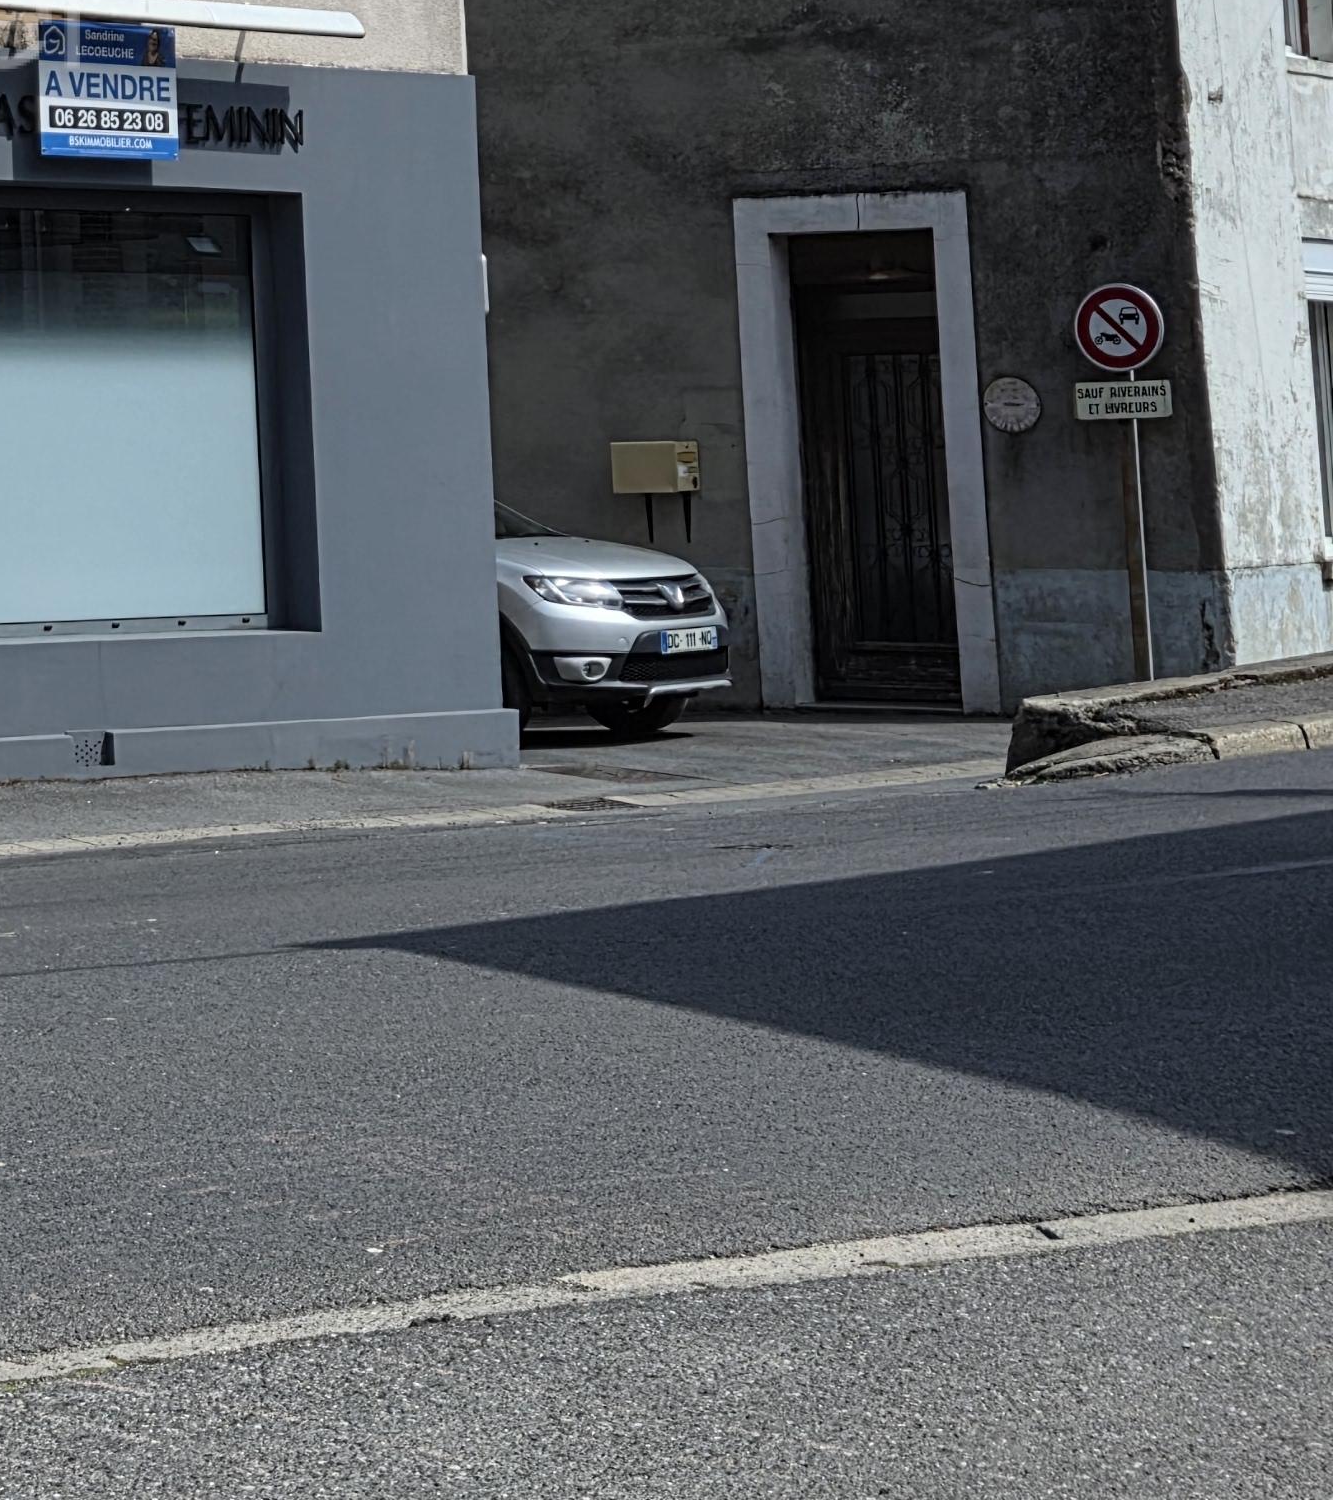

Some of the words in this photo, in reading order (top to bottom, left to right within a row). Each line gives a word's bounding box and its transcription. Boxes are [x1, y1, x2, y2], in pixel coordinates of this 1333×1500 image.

[85, 29, 125, 42] Sandrine
[75, 45, 134, 59] LECOEUCHE
[45, 70, 63, 97] A
[68, 71, 171, 102] VENDRE
[54, 108, 74, 127] 06
[77, 109, 97, 128] 26
[100, 111, 120, 129] 85
[123, 112, 142, 130] 23
[145, 113, 164, 131] 08
[69, 136, 153, 149] BSKIMMOBILIER.COM
[1077, 387, 1104, 399] SAUF
[1110, 385, 1167, 398] RIVERAINS
[1088, 403, 1099, 415] ET
[1105, 401, 1158, 414] LIVREURS
